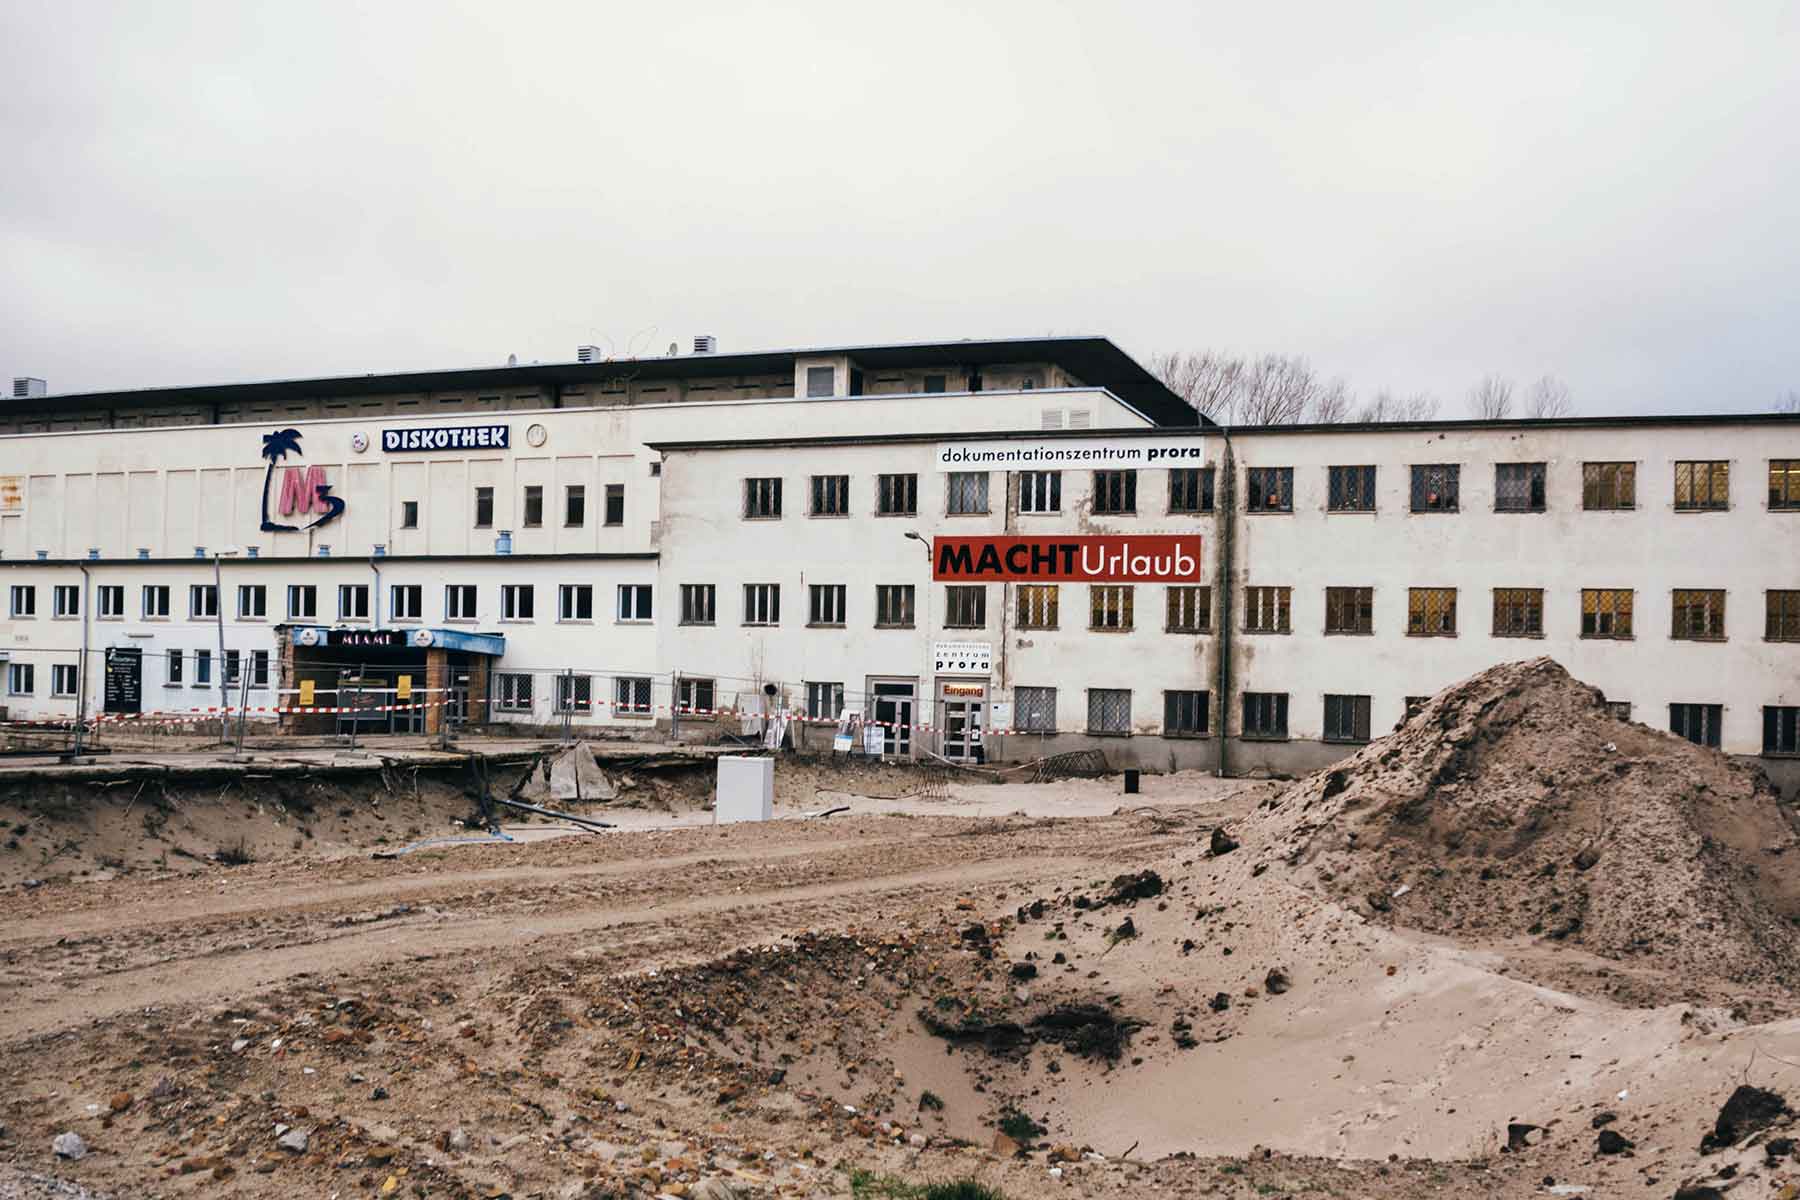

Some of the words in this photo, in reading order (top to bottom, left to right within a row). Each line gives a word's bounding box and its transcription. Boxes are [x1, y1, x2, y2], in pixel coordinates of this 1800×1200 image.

[386, 428, 505, 449] DISKOTHEK
[941, 446, 1142, 462] dokumentationszentrum
[1148, 447, 1200, 461] prora
[341, 633, 391, 646] MIAMI
[936, 661, 988, 670] prora
[944, 685, 983, 697] Eingang
